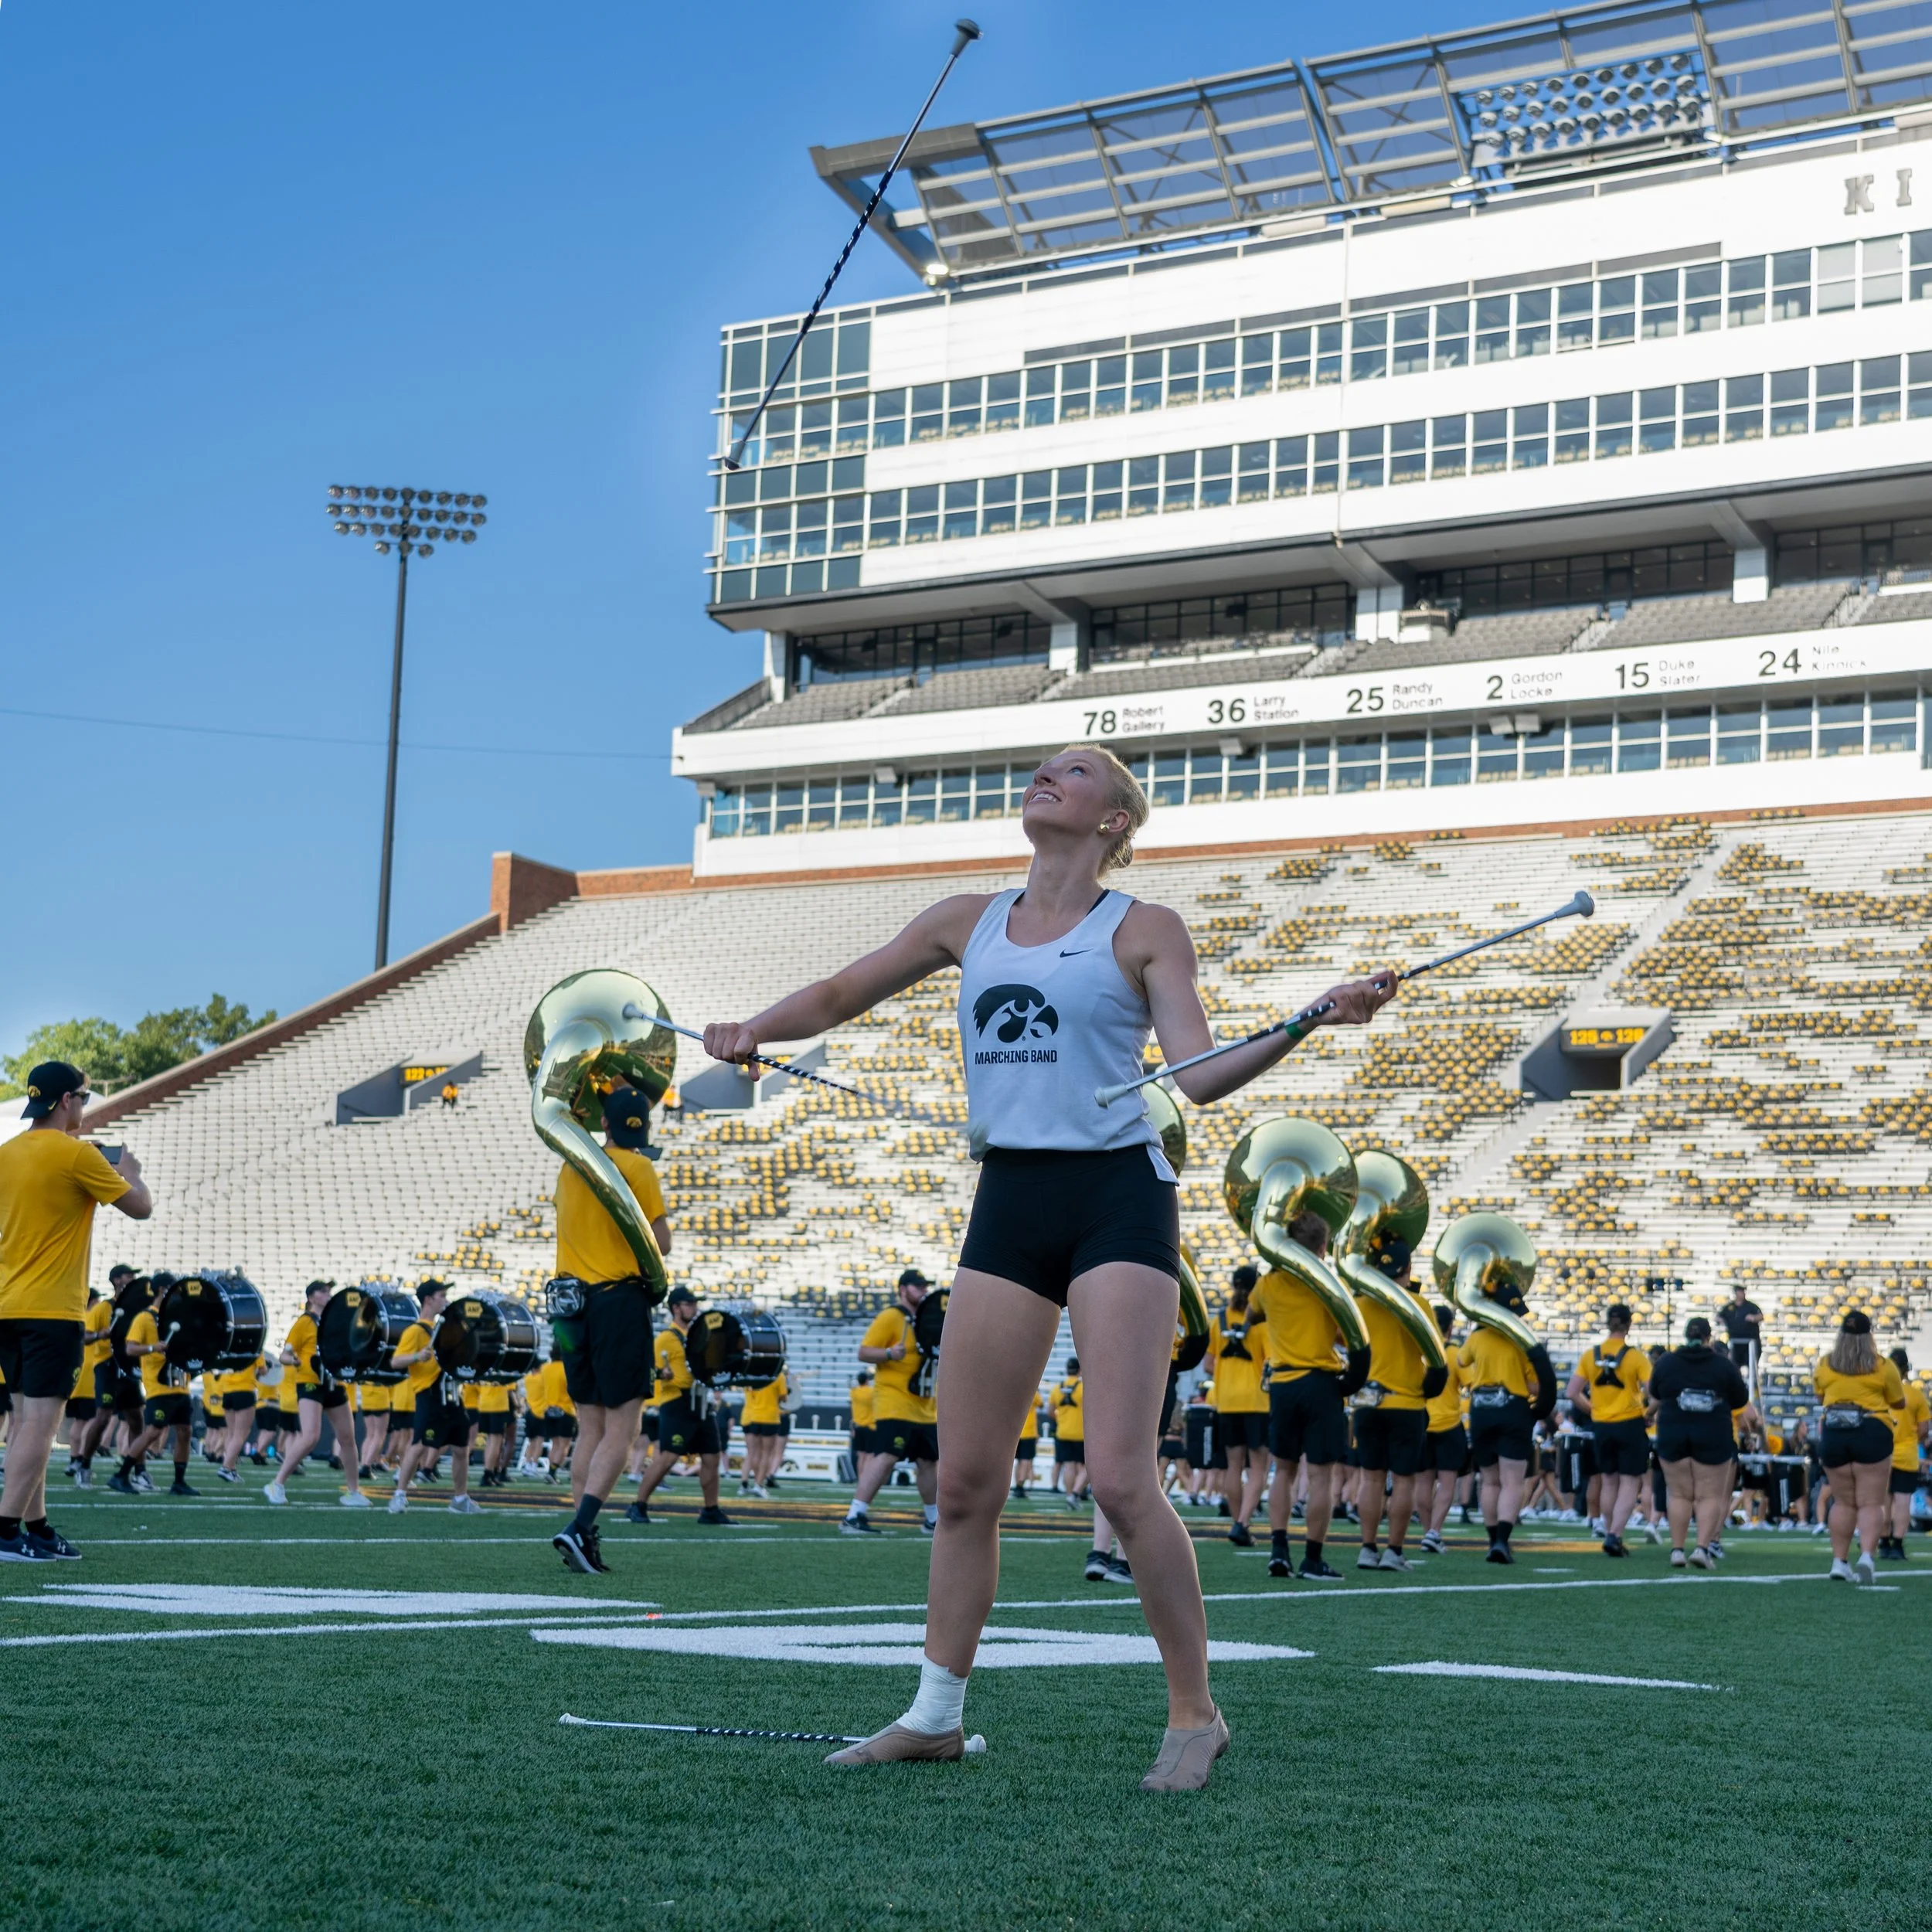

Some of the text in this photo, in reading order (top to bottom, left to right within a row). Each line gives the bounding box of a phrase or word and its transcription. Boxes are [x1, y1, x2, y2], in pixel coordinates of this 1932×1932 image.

[1813, 645, 1840, 655] Nile
[1659, 659, 1695, 672] Duke
[1759, 648, 1802, 678] 24
[1512, 671, 1563, 685] Gordon
[1615, 662, 1650, 689] 15
[1659, 672, 1701, 685] Slater
[1393, 682, 1433, 696] Randy
[1486, 675, 1504, 701] 2
[1511, 687, 1553, 699] Locke
[1253, 695, 1287, 706] Larry
[1346, 686, 1384, 714] 25
[1393, 697, 1443, 710] Duncan
[1122, 706, 1163, 718] Robert
[1207, 699, 1246, 723] 36
[1253, 706, 1299, 720] Station
[1083, 710, 1116, 736] 78
[1122, 720, 1165, 733] Gallery
[975, 1049, 1057, 1064] MARCHING BAND
